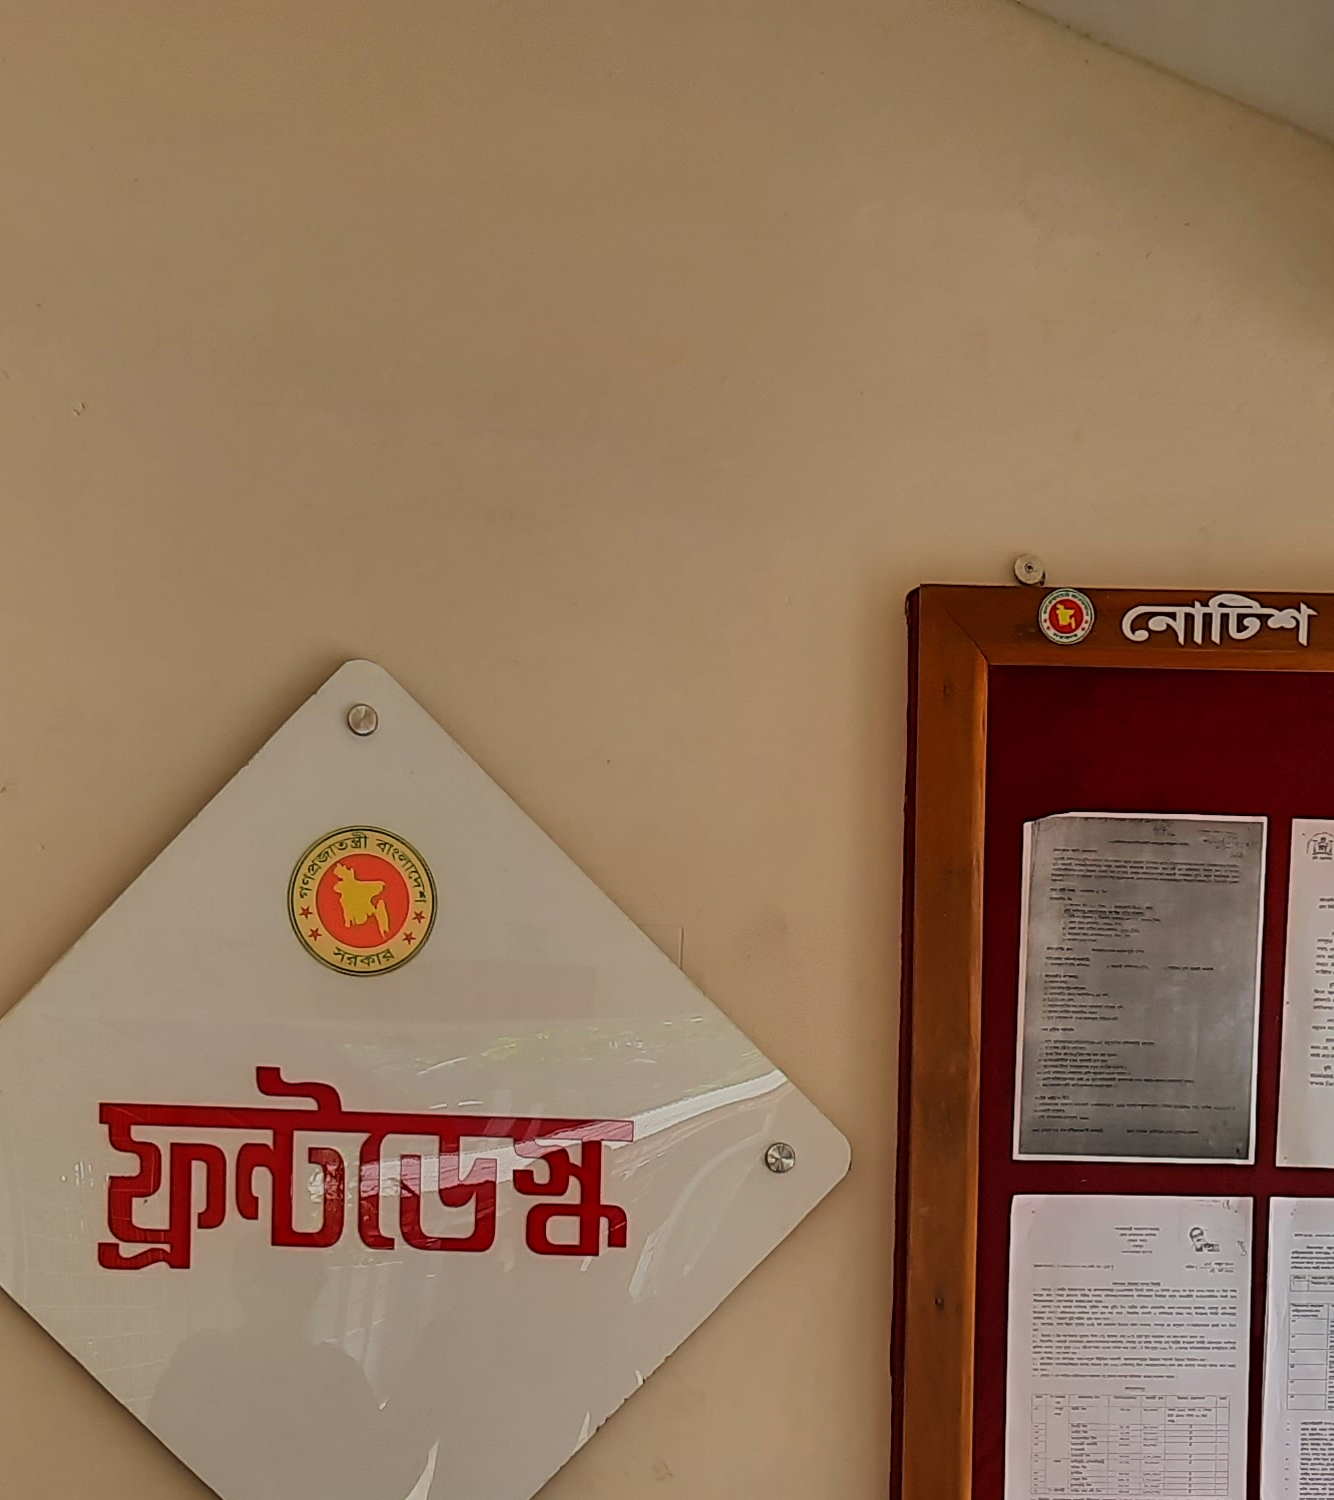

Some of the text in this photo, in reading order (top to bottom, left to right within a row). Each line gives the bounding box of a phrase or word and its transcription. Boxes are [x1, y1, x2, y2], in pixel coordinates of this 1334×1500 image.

[1122, 593, 1317, 647] নোটিশ
[376, 839, 426, 903] বাংলাদেশ
[333, 946, 394, 966] সরকার
[98, 1065, 634, 1270] ফ্রন্টডেস্ক
